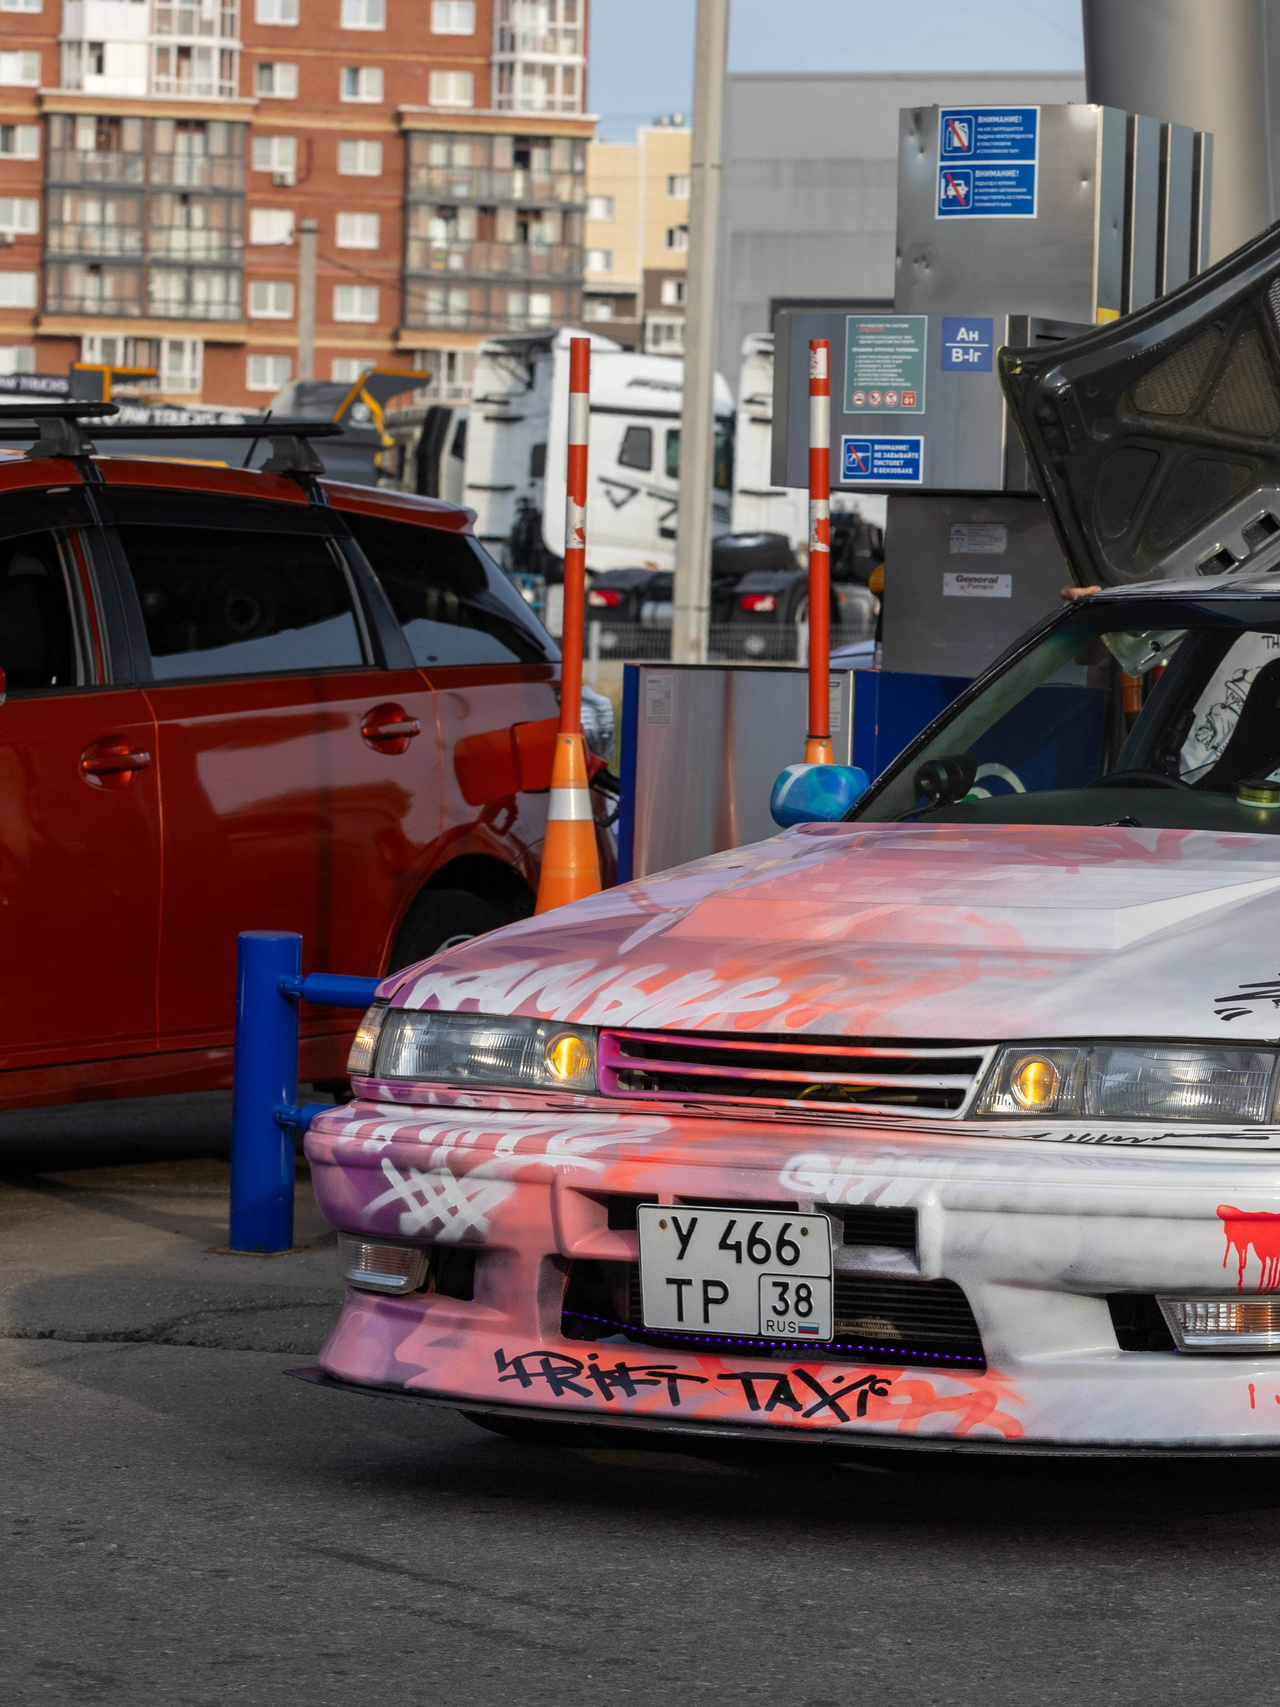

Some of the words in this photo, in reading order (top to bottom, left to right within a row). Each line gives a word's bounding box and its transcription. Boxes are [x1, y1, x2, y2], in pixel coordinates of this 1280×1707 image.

[956, 327, 979, 341] Ан
[956, 574, 999, 584] General
[671, 1216, 698, 1260] У
[718, 1219, 801, 1266] 466
[665, 1277, 729, 1324] ТР
[771, 1281, 814, 1318] 38
[766, 1319, 796, 1333] RUS
